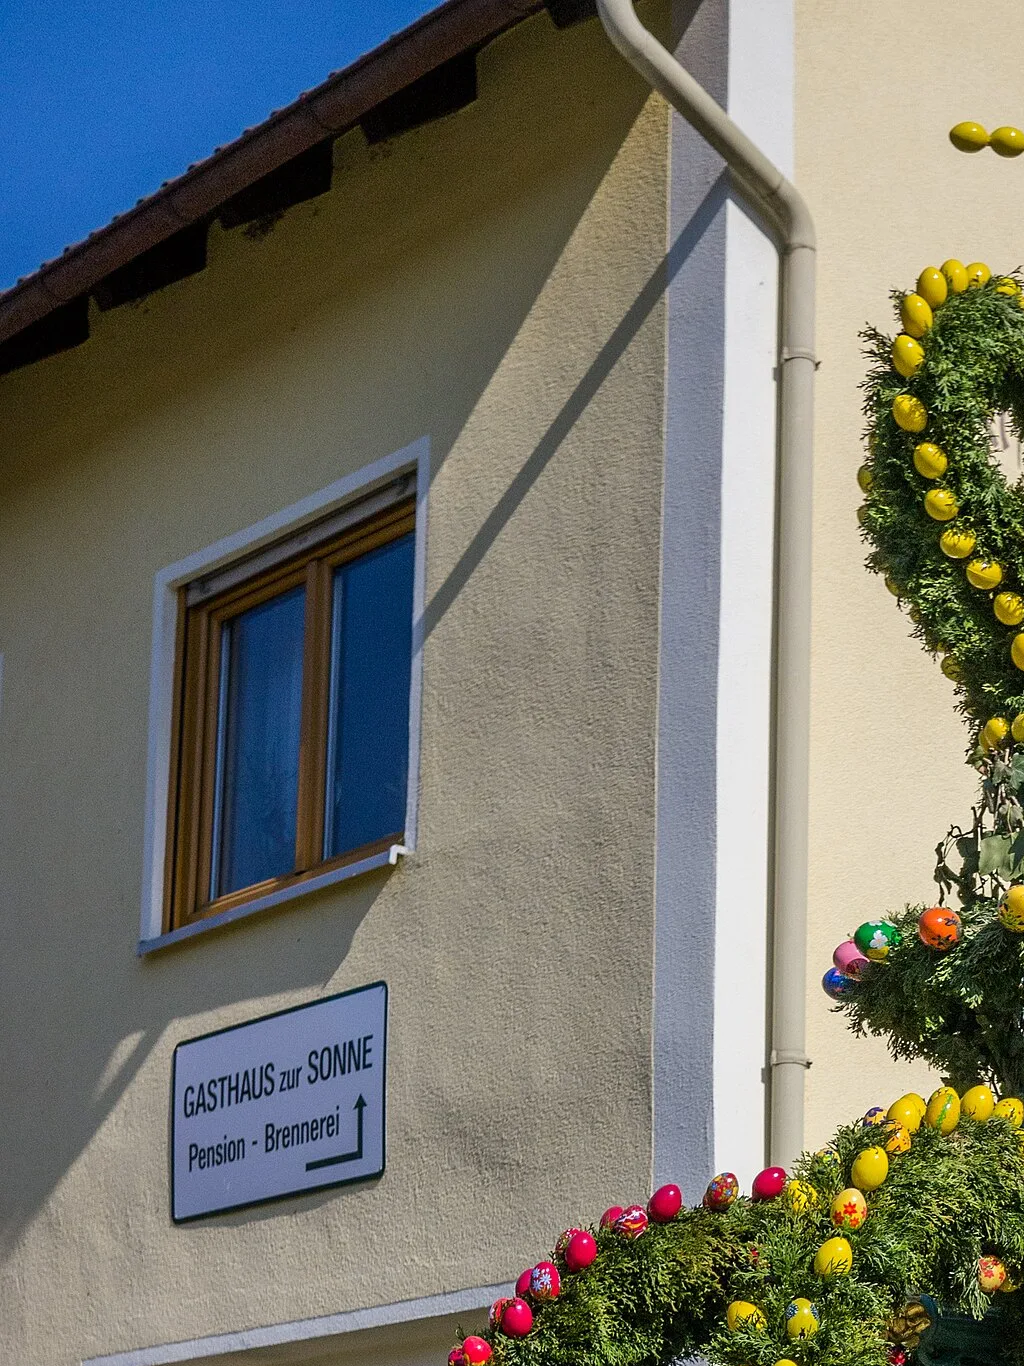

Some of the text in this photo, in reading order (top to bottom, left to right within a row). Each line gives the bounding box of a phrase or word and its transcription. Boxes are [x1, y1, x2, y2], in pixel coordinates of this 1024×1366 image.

[183, 1034, 374, 1118] GASTHAUS zur SONNE
[188, 1135, 246, 1173] Pension
[264, 1105, 340, 1153] Brennerei
